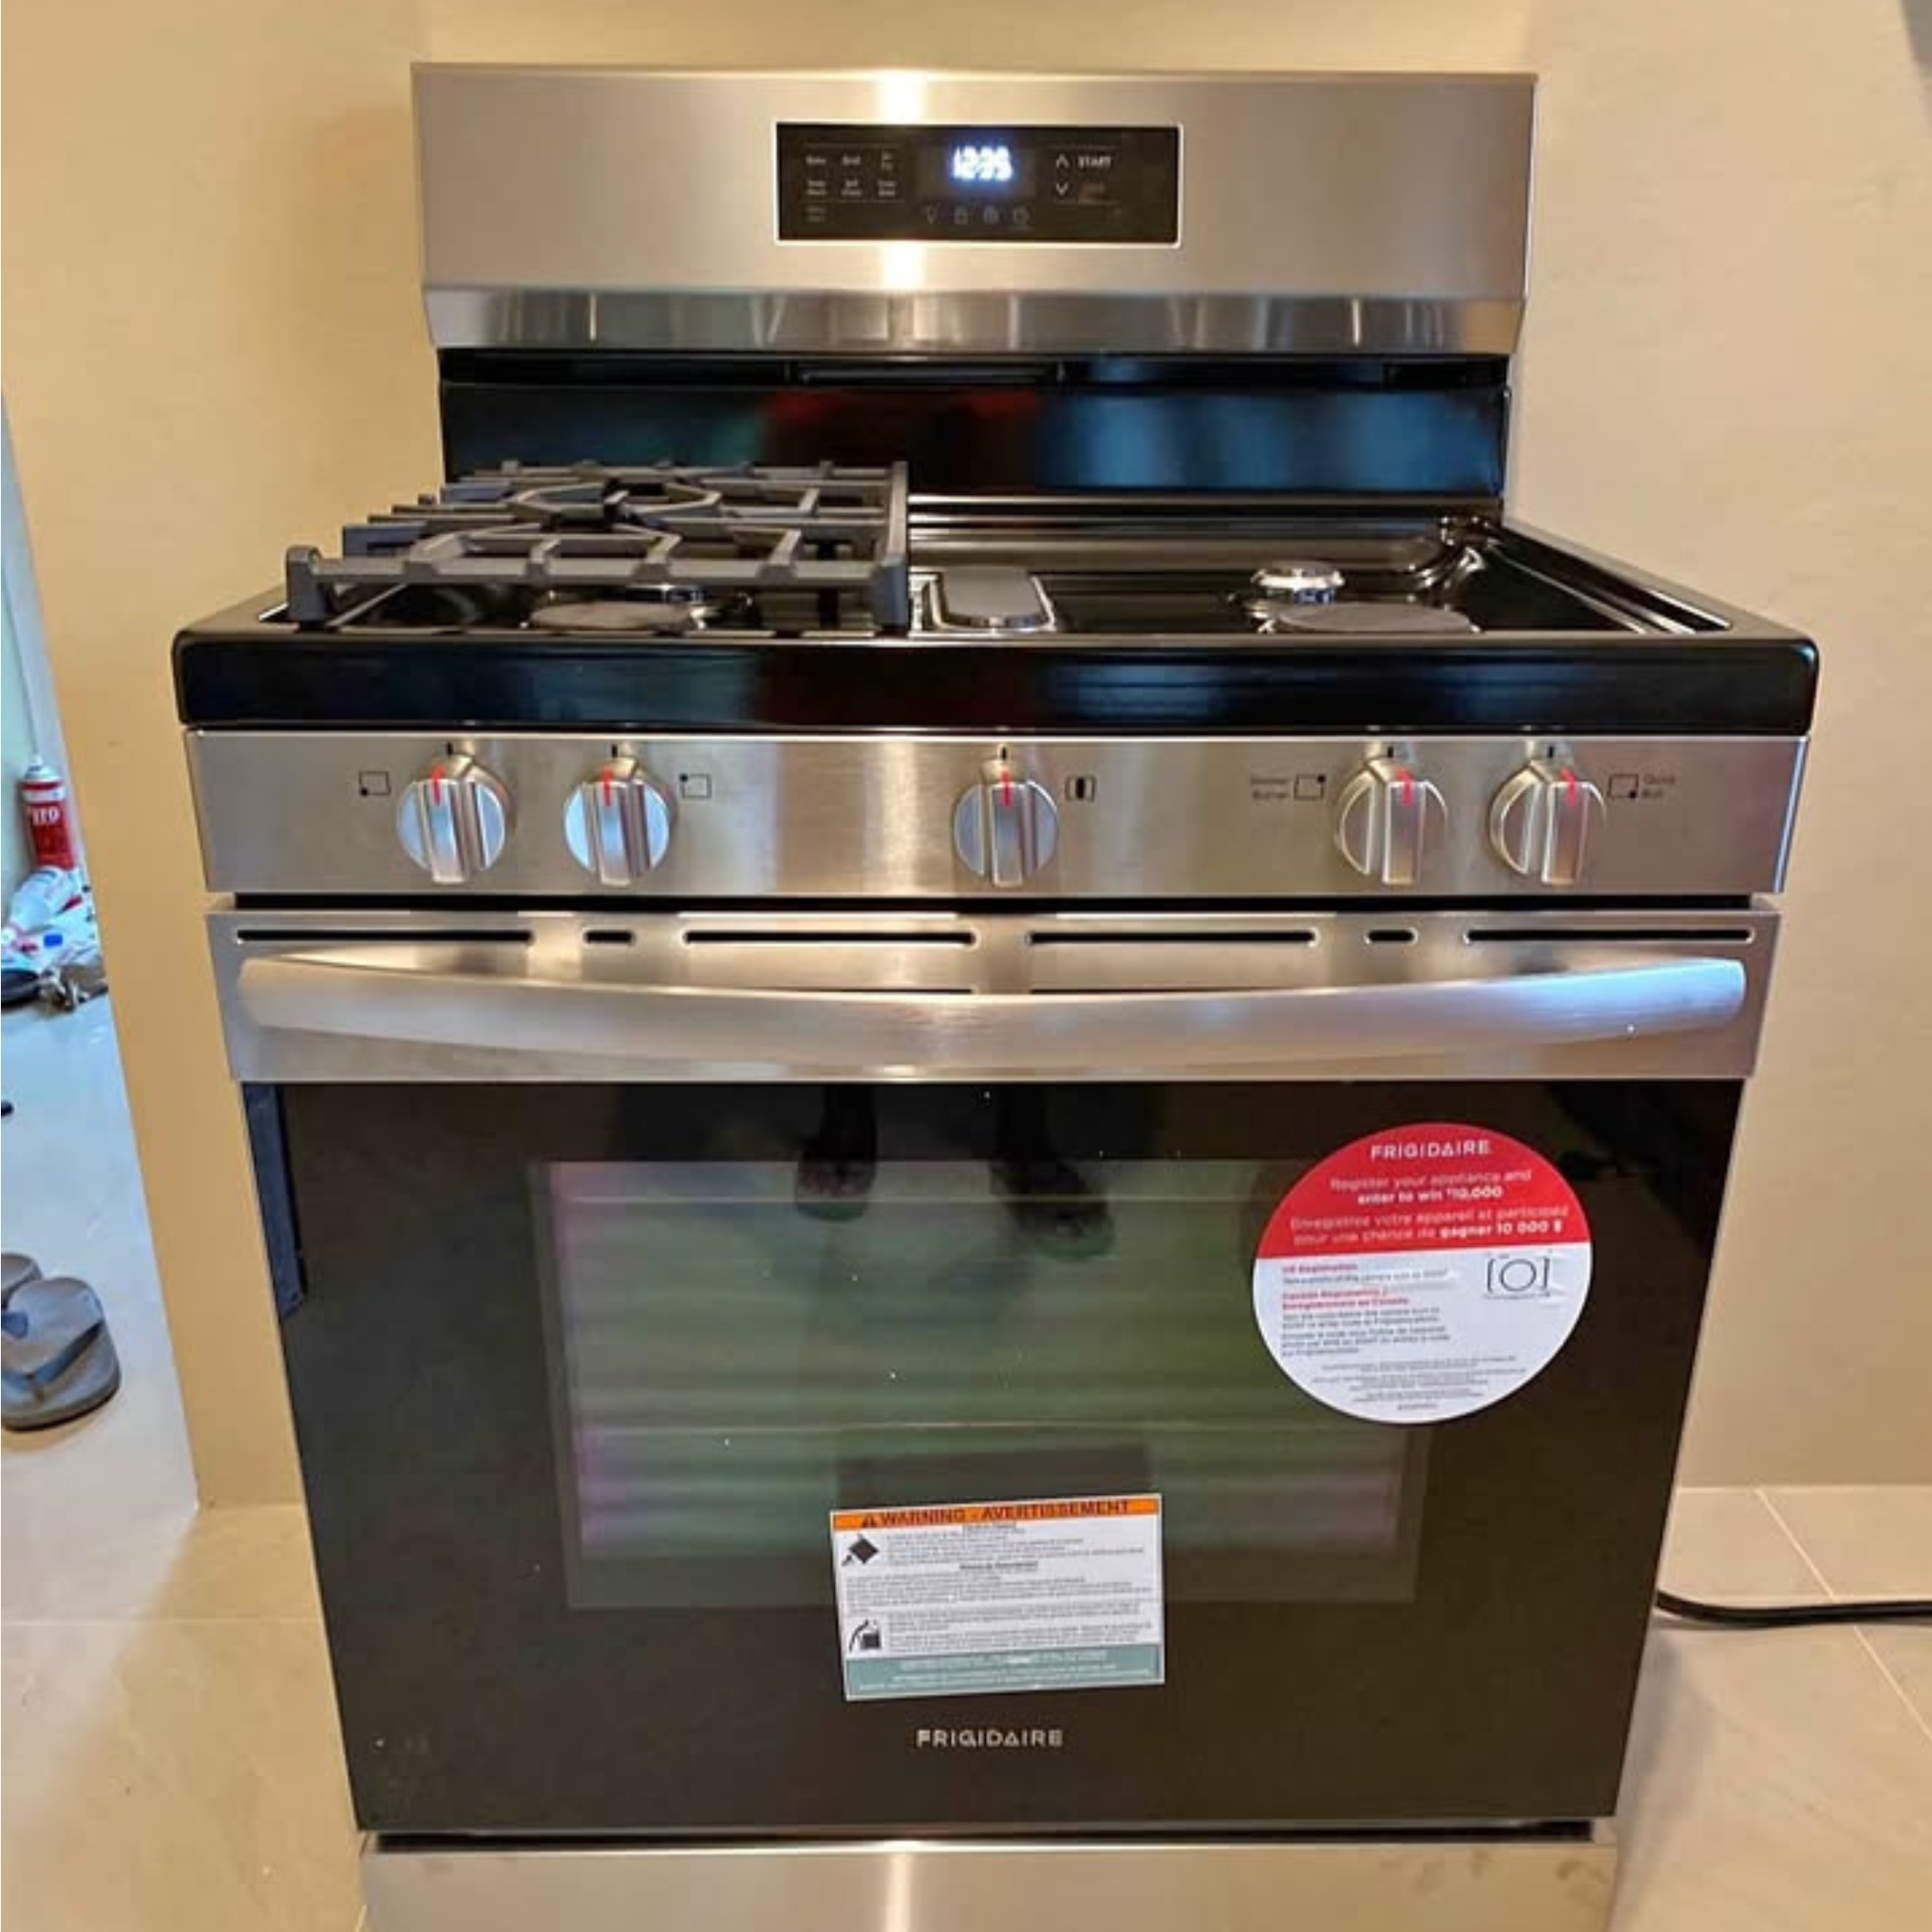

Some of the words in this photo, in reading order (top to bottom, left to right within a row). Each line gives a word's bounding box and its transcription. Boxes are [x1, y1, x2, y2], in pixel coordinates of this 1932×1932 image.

[1077, 155, 1112, 169] START
[1370, 1140, 1490, 1161] FRIGIDAIRE
[1330, 1175, 1388, 1192] Register
[1394, 1174, 1426, 1189] your
[1431, 1171, 1500, 1187] appliance
[1504, 1169, 1532, 1182] and
[1357, 1191, 1394, 1205] enter
[1399, 1190, 1414, 1202] to
[1419, 1188, 1443, 1201] win
[1294, 1232, 1327, 1247] pour
[1440, 1224, 1492, 1240] gagner
[1496, 1221, 1512, 1234] 10
[1516, 1220, 1549, 1234] 000
[881, 1507, 965, 1527] WARNING
[982, 1500, 1131, 1521] AVERTISSEMENT
[915, 1727, 1064, 1748] FRIGIDAIRE
